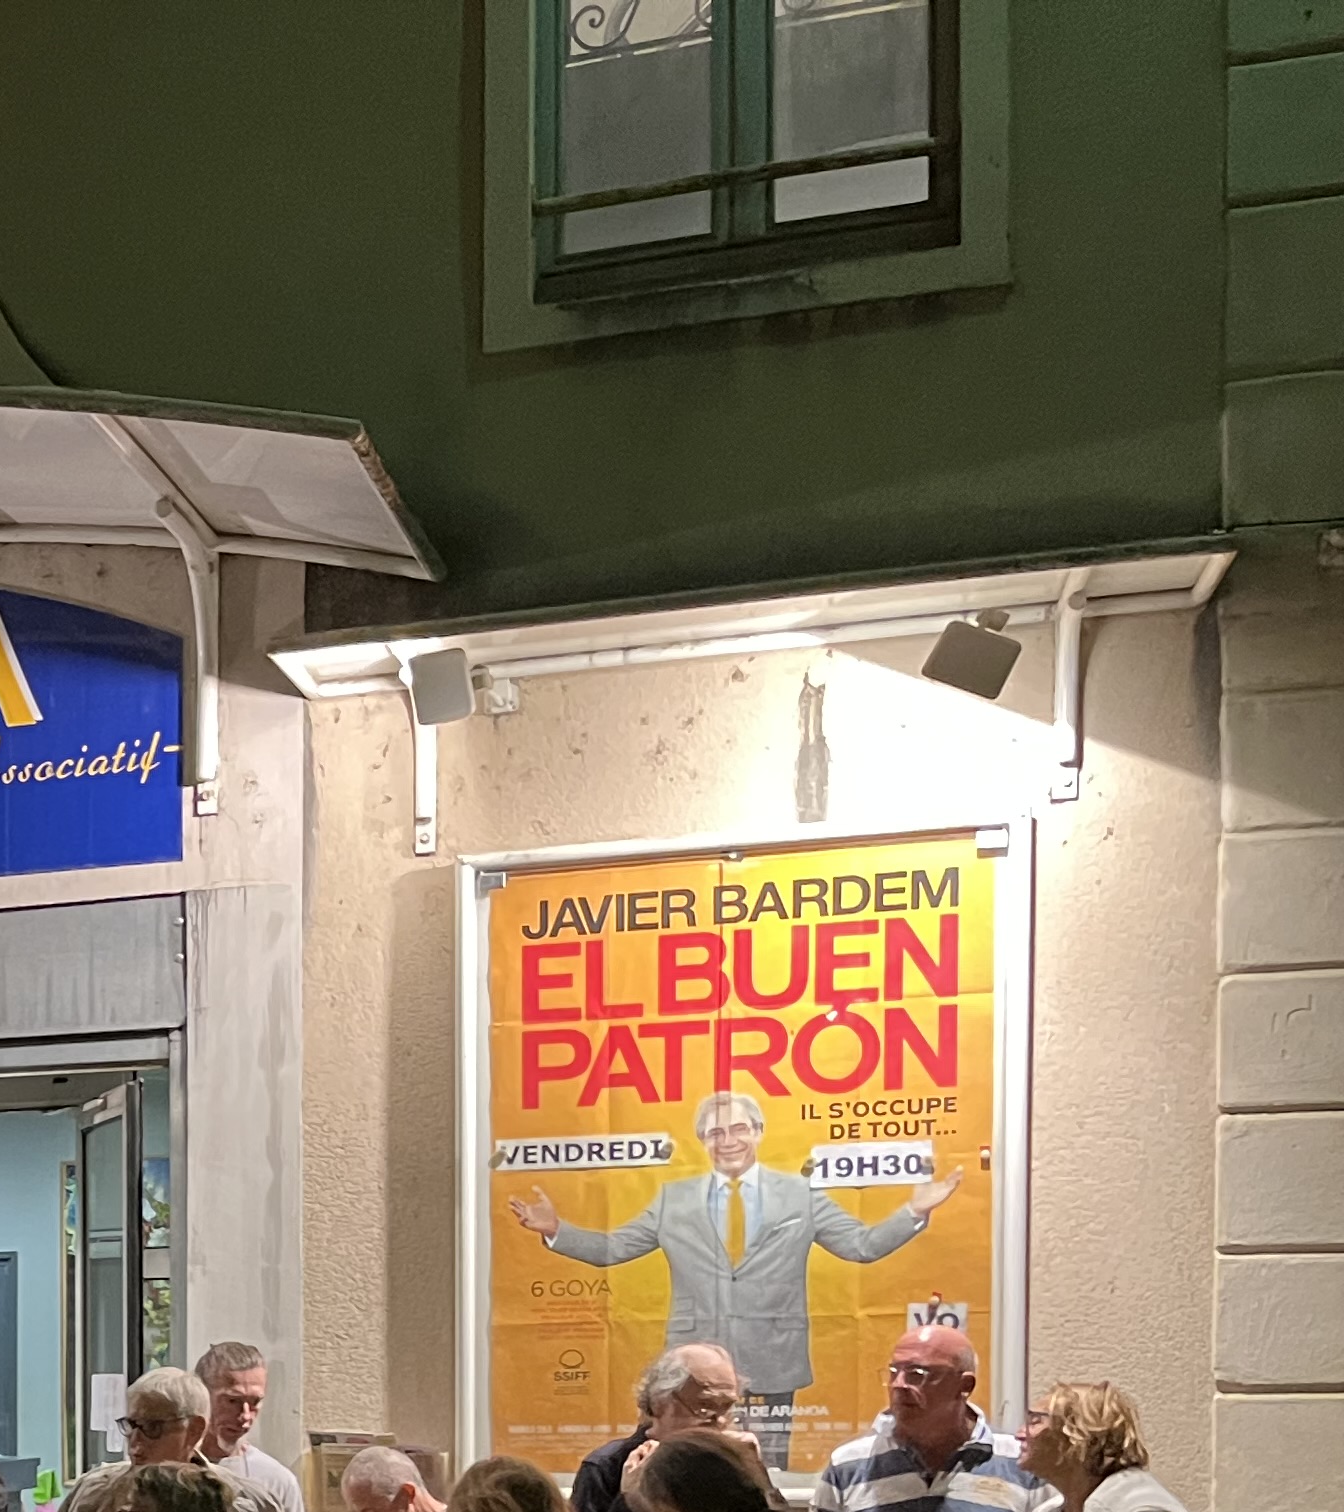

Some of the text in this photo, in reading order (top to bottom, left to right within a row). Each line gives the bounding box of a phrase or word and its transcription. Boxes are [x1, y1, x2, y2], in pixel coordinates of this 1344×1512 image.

[520, 865, 960, 940] JAVIER BARDEM
[521, 913, 959, 1025] EL BUEN
[801, 1097, 957, 1120] IL S'OCCUPE
[830, 1119, 957, 1140] DE TOUT...
[501, 1139, 663, 1165] VENDREDI
[815, 1153, 924, 1179] 19H30
[531, 1279, 613, 1298] 6 GOYA
